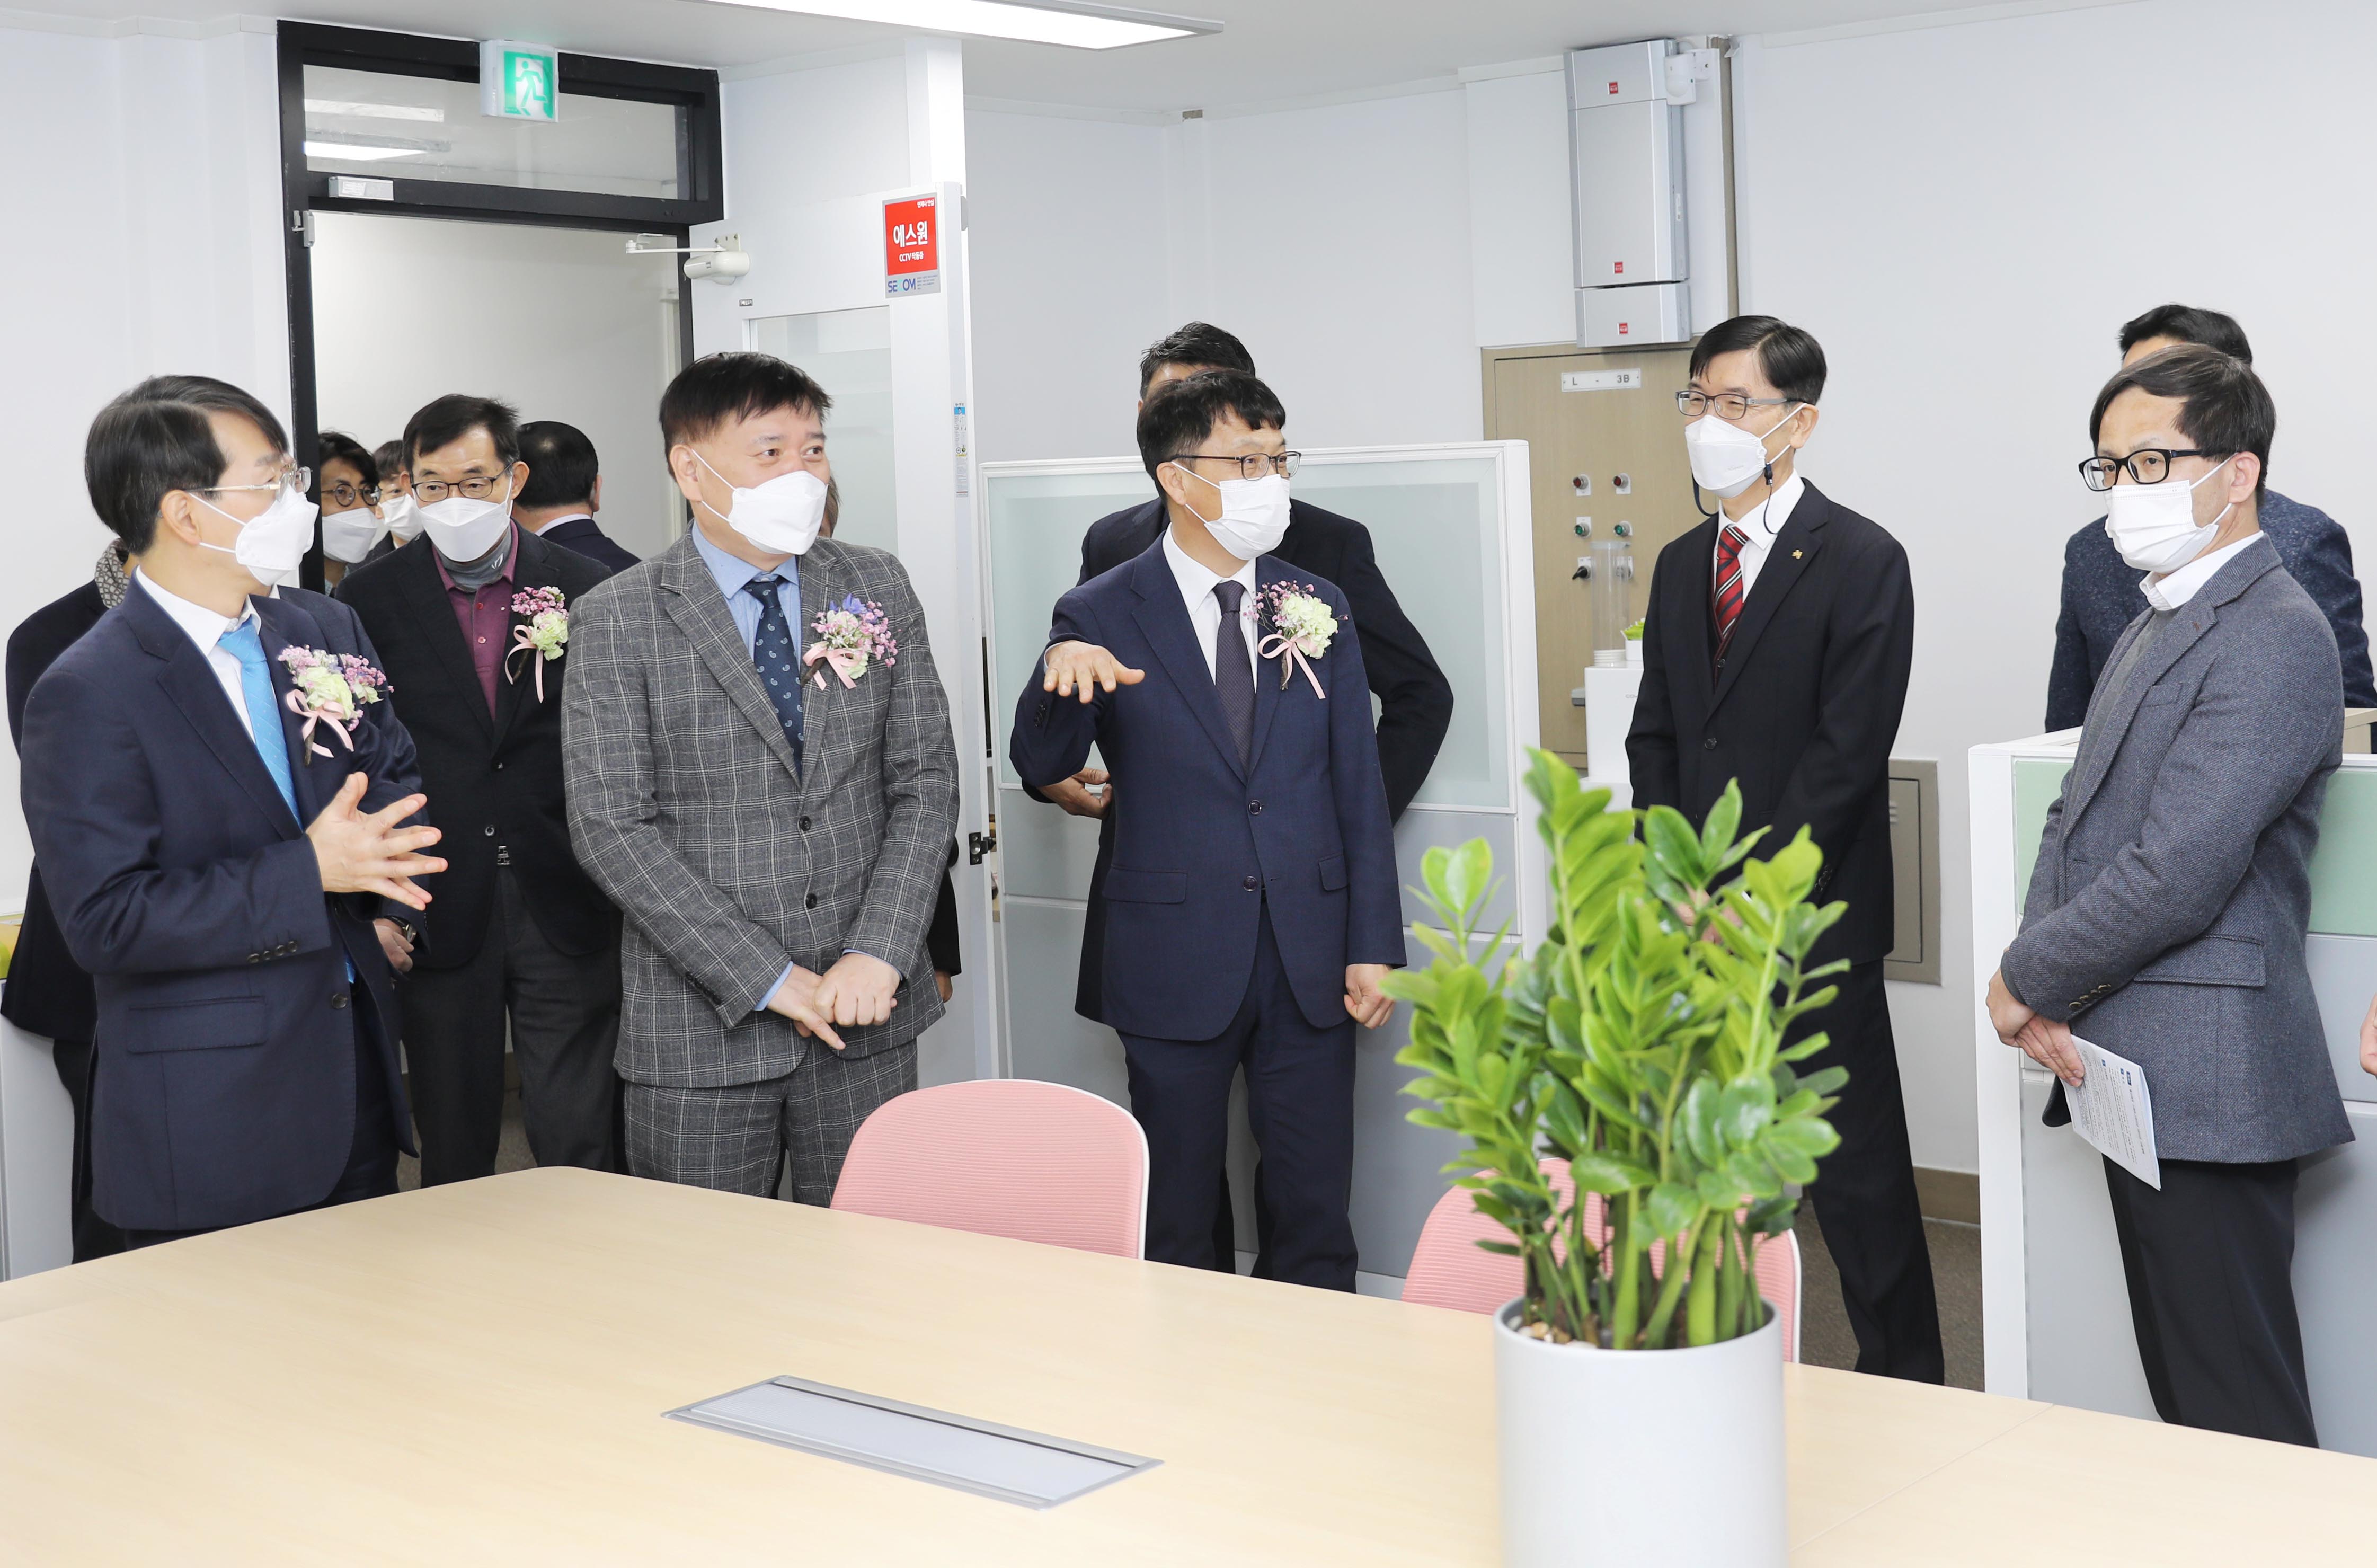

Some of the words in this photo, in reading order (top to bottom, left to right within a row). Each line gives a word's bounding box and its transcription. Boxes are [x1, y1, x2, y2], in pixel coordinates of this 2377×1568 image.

[893, 220, 928, 247] 에스원
[899, 253, 911, 262] CCTV
[1572, 377, 1577, 386] L
[1617, 374, 1630, 383] 3B
